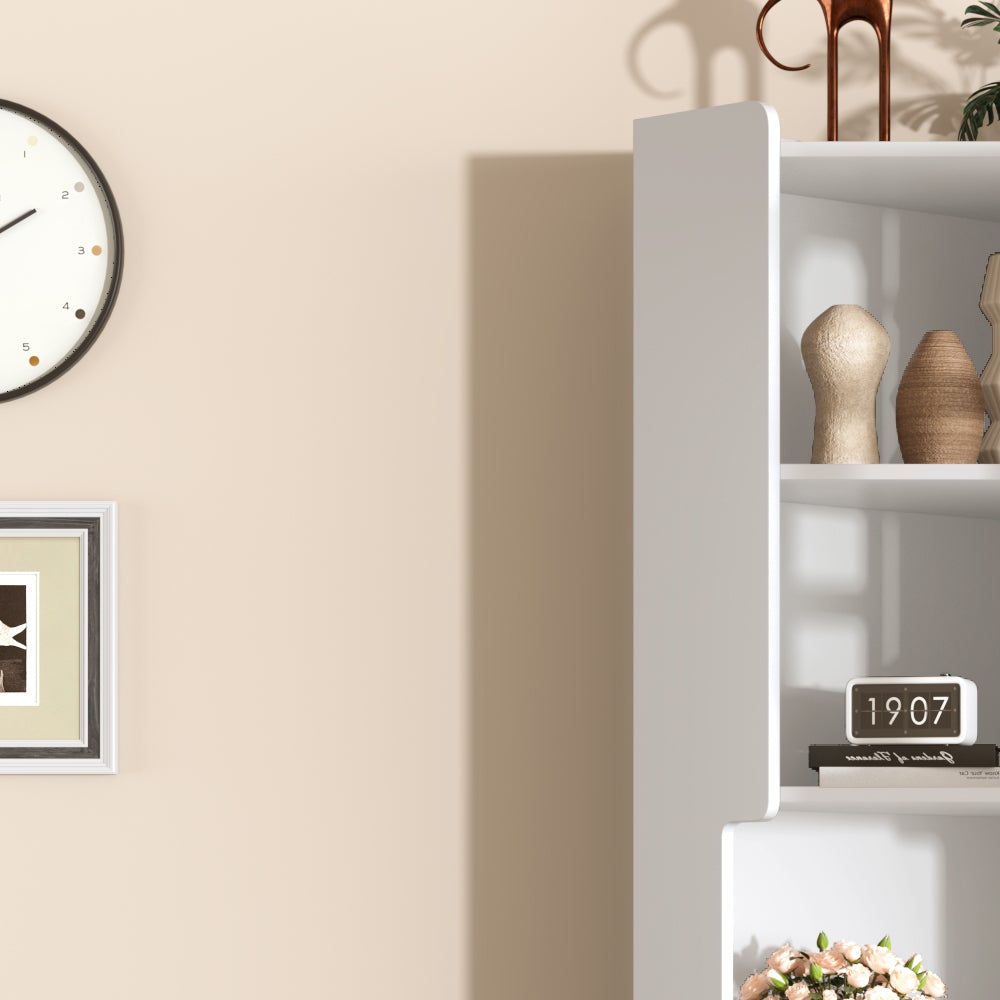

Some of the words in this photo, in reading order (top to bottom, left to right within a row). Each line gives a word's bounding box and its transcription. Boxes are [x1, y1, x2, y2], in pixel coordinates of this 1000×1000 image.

[61, 190, 70, 200] 2
[77, 246, 85, 255] 3
[62, 302, 70, 310] 4
[22, 343, 30, 351] 5
